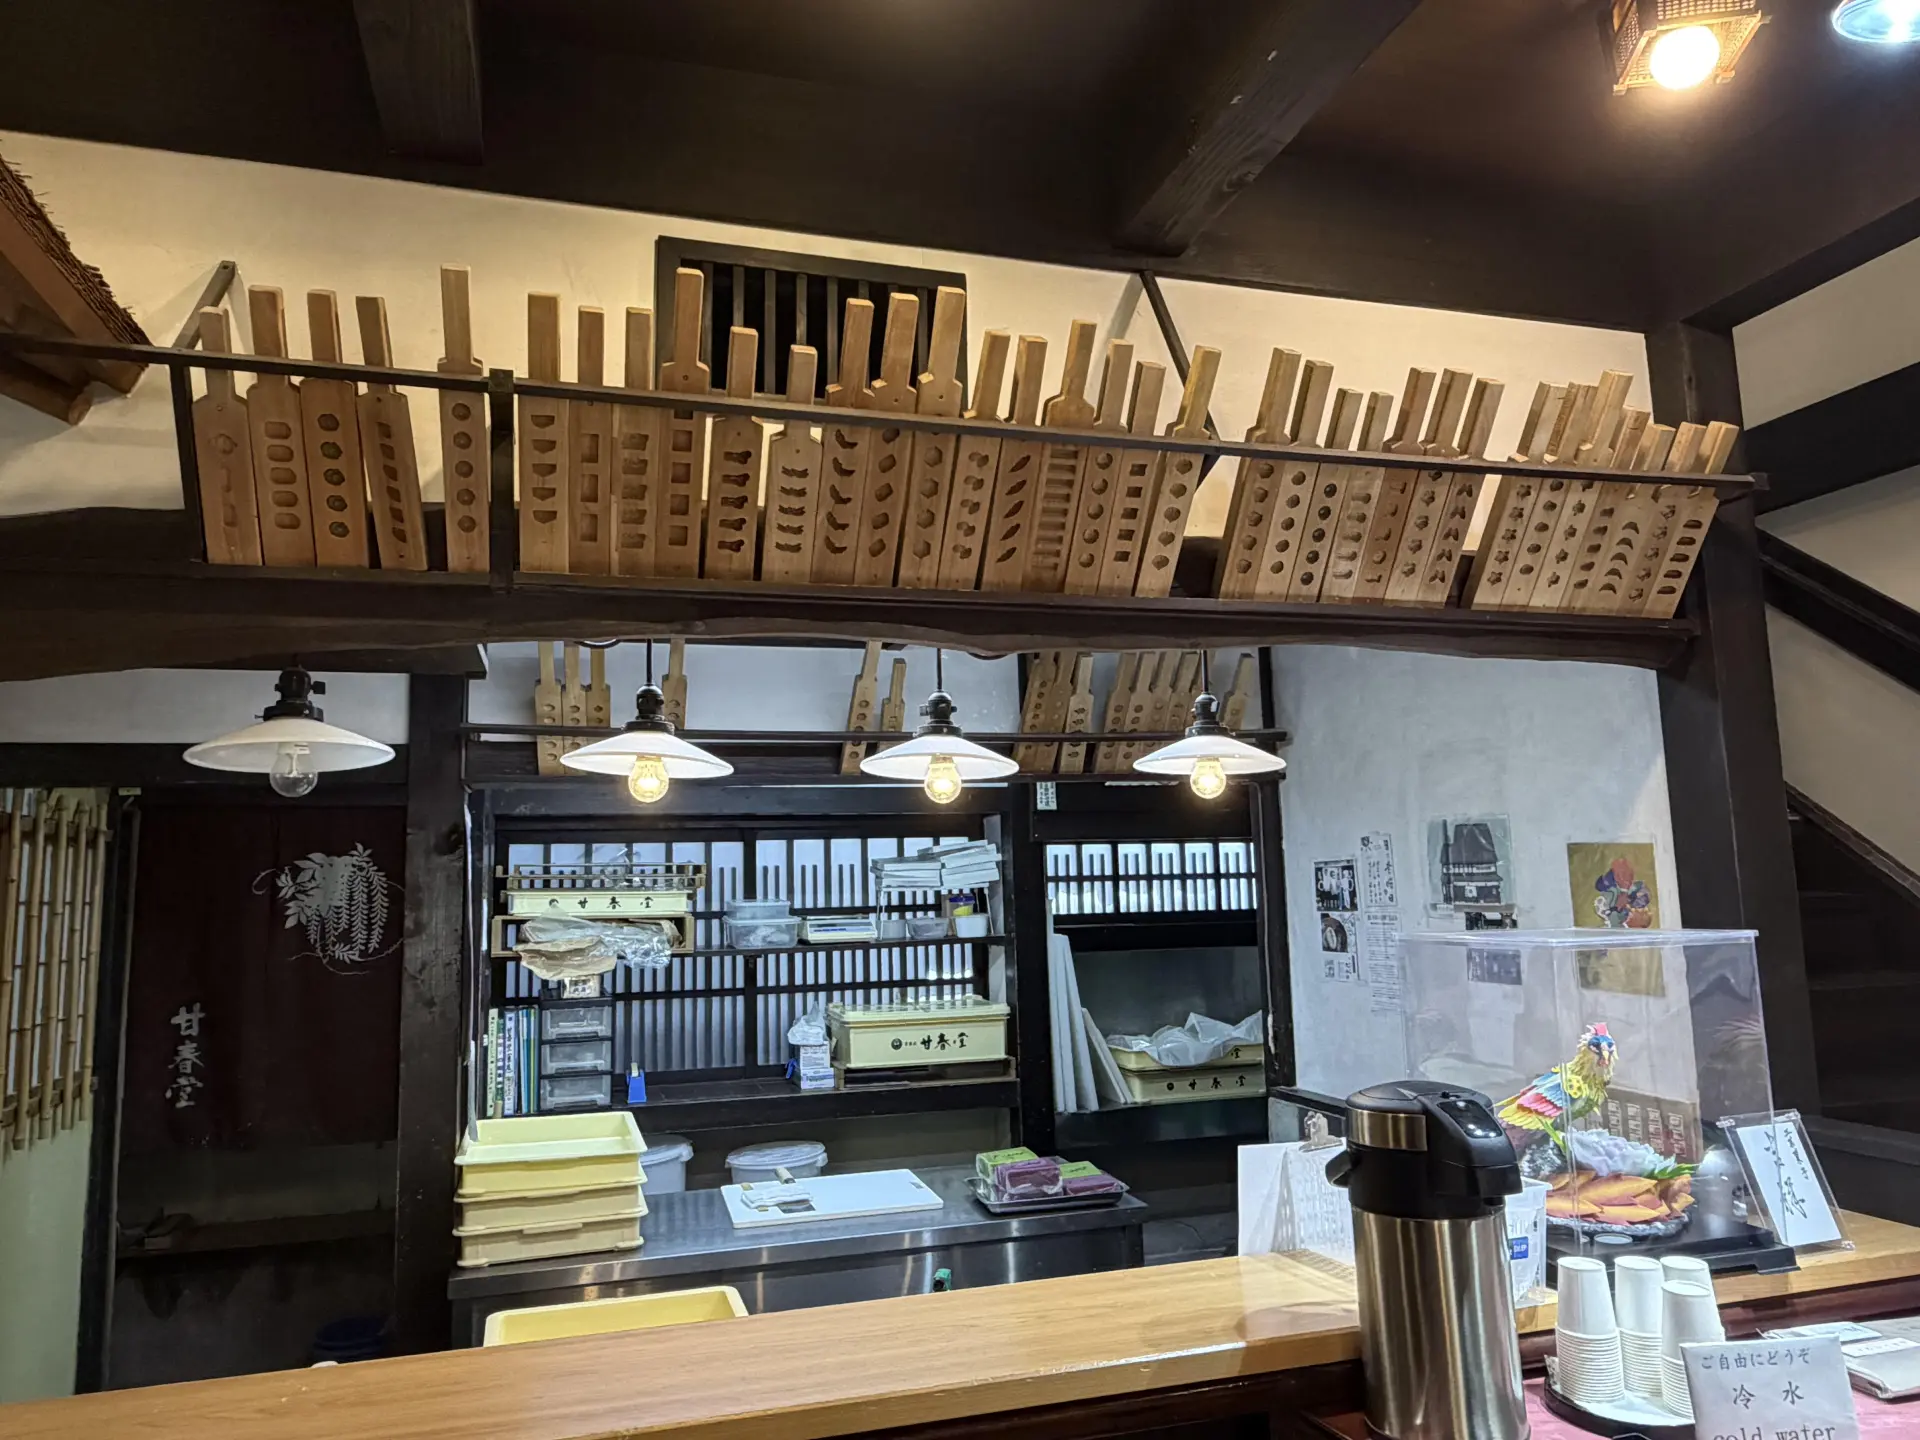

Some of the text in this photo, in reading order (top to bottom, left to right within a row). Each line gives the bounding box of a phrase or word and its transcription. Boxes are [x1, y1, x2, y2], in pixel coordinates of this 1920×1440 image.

[577, 896, 654, 910] 甘春堂
[920, 1032, 969, 1050] 甘春堂
[165, 1002, 206, 1109] 甘春堂
[1701, 1347, 1811, 1370] ご自由にどうぞ
[1776, 1424, 1836, 1440] water
